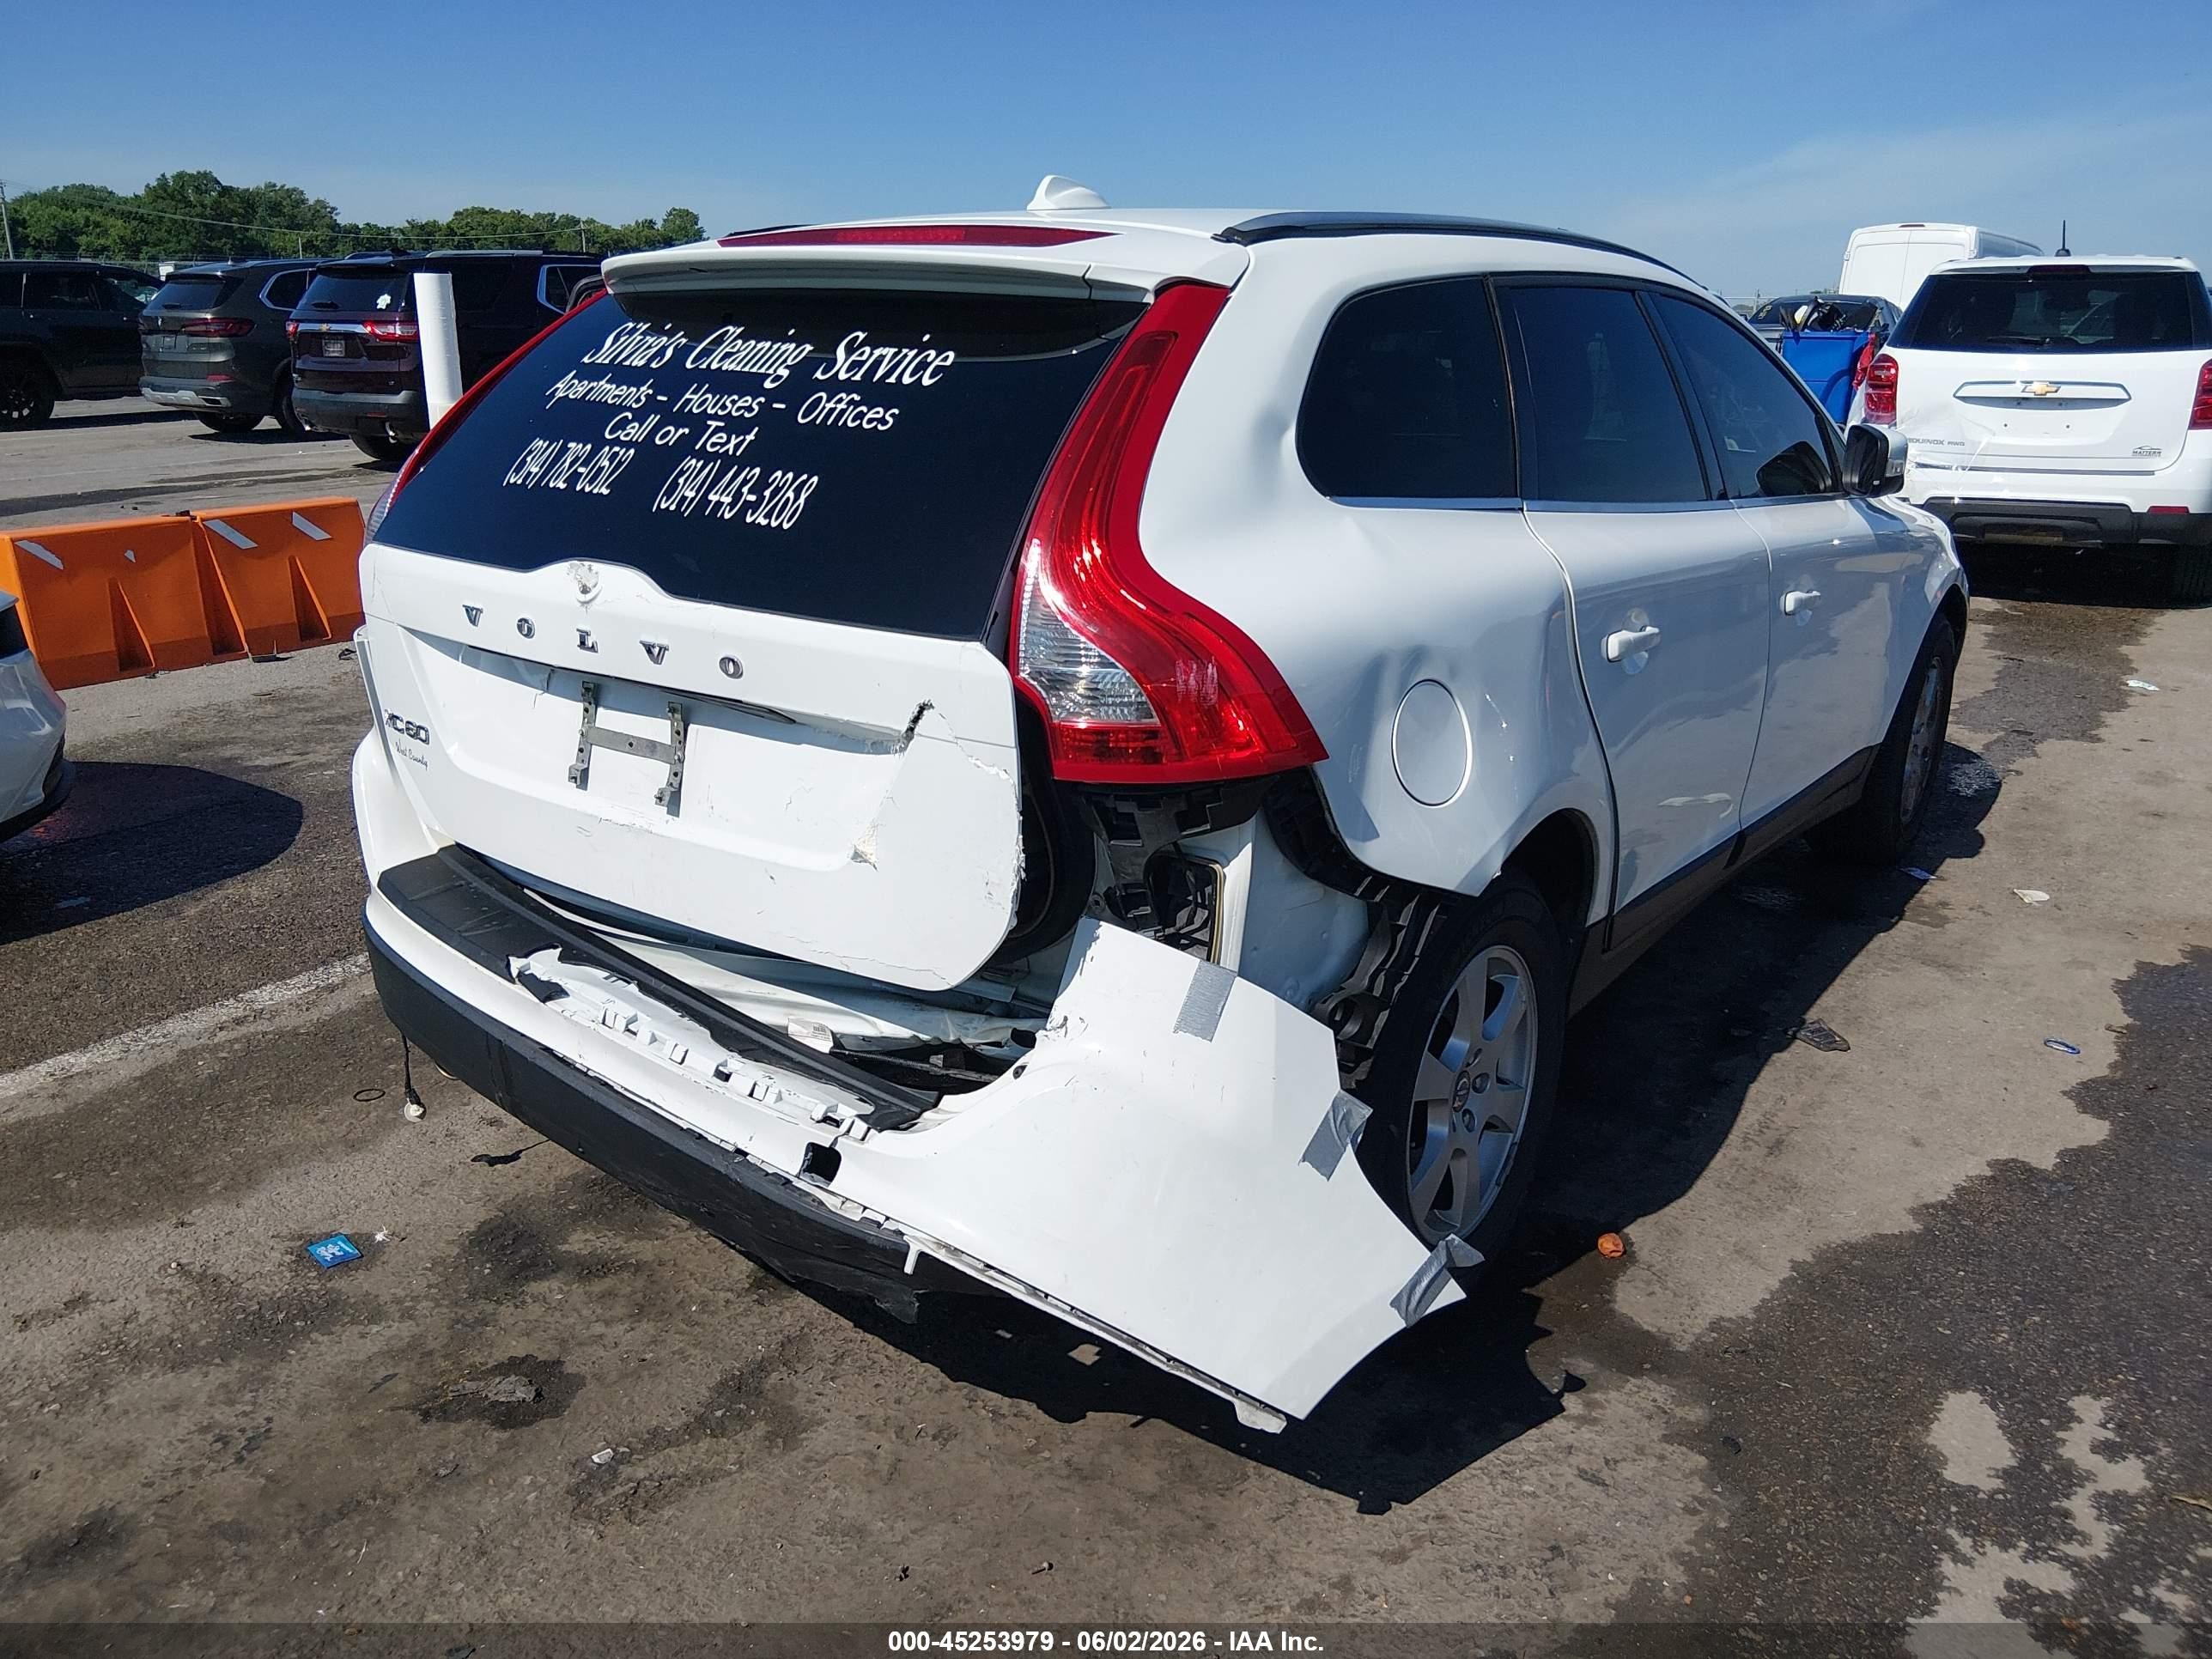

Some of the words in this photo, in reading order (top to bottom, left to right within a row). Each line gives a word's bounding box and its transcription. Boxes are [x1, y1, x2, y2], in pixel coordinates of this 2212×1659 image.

[580, 322, 688, 368] Silvia's
[684, 325, 815, 389] Cleaning
[812, 331, 956, 386] Service
[545, 370, 653, 410] Apartments
[672, 384, 766, 418] Houses
[797, 392, 900, 431] Offices
[604, 411, 661, 443] Call
[655, 425, 690, 447] or
[695, 420, 759, 457] Text
[503, 437, 564, 489] (314)
[540, 441, 635, 495] 782-0512
[652, 455, 722, 518] (314)
[704, 465, 819, 530] 443-3268
[462, 604, 744, 680] VOLVO
[384, 708, 430, 745] XC60
